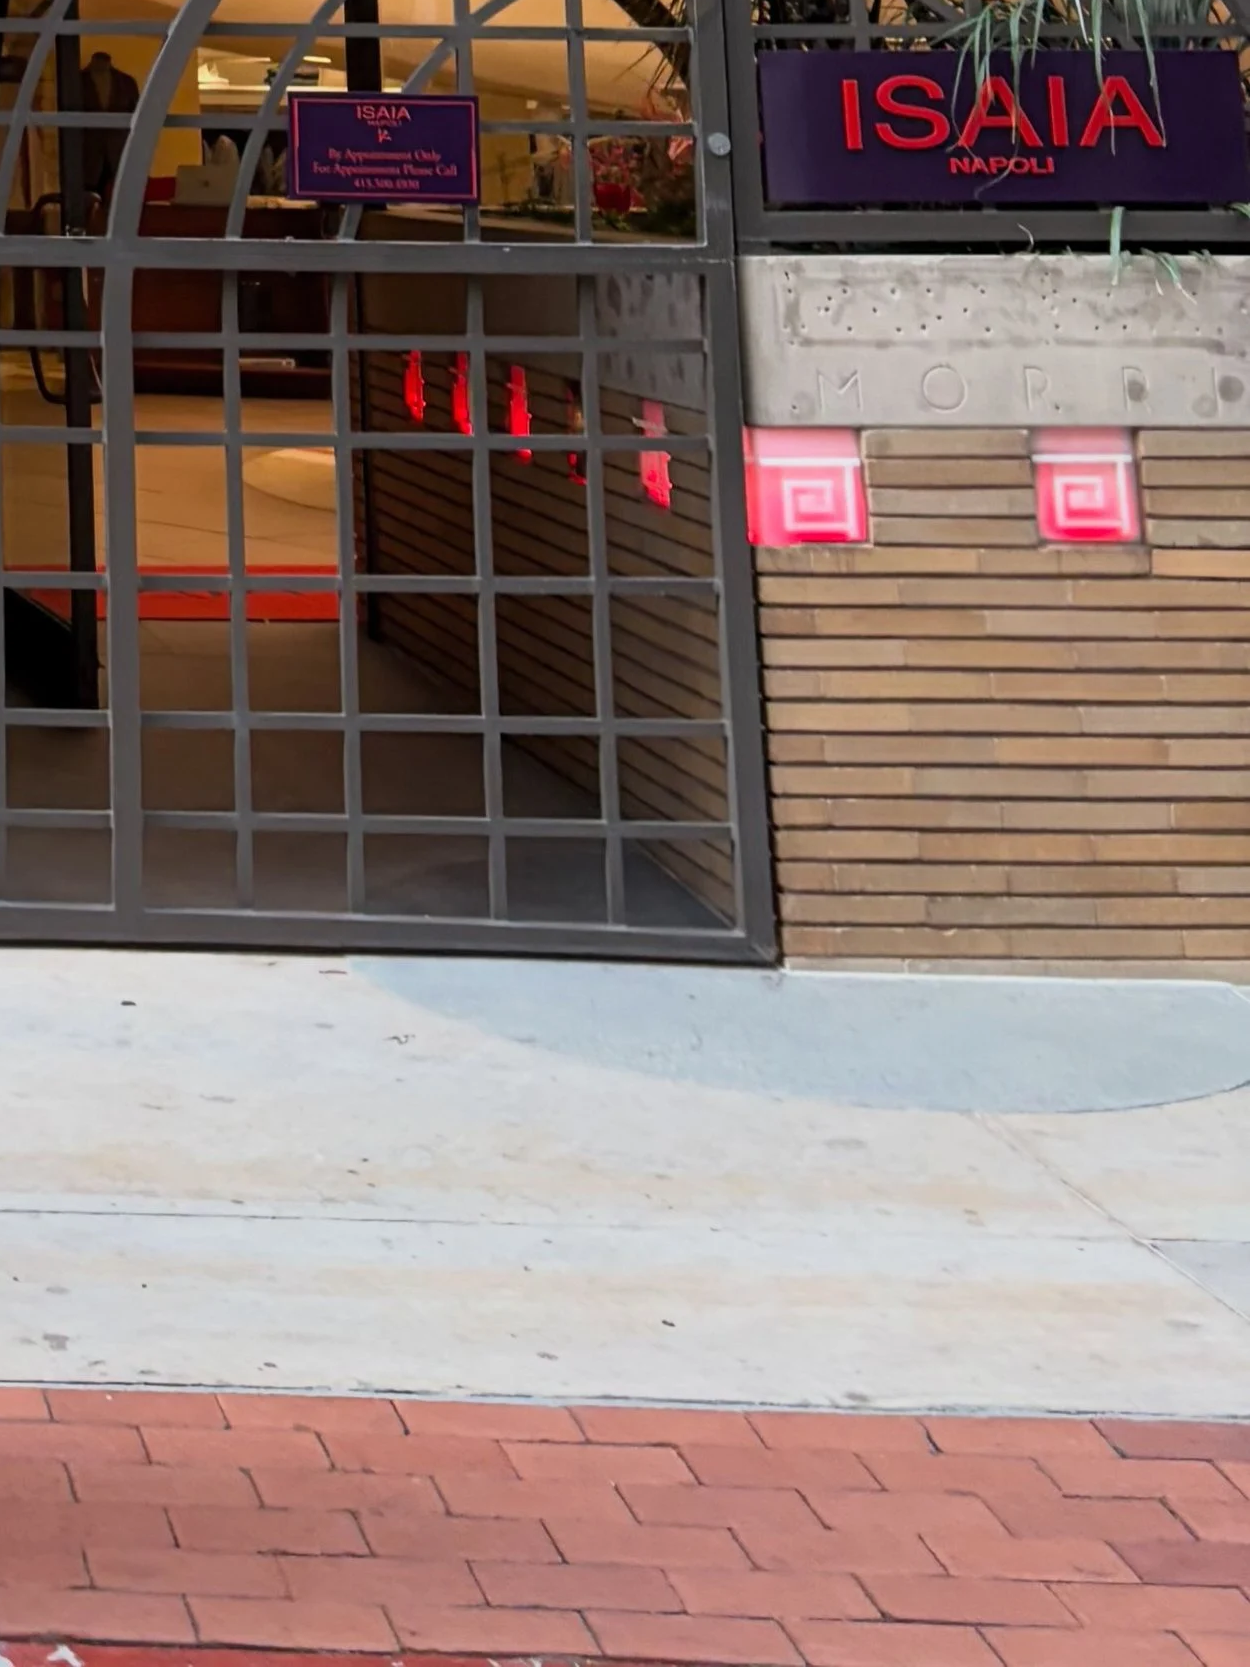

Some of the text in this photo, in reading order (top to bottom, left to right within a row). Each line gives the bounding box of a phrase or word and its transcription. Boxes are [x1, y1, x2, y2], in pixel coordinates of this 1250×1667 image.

[356, 105, 411, 121] ISAIA
[840, 74, 1166, 151] ISAIA
[312, 161, 331, 175] For
[435, 163, 458, 178] Call
[949, 156, 1055, 175] NAPOLI
